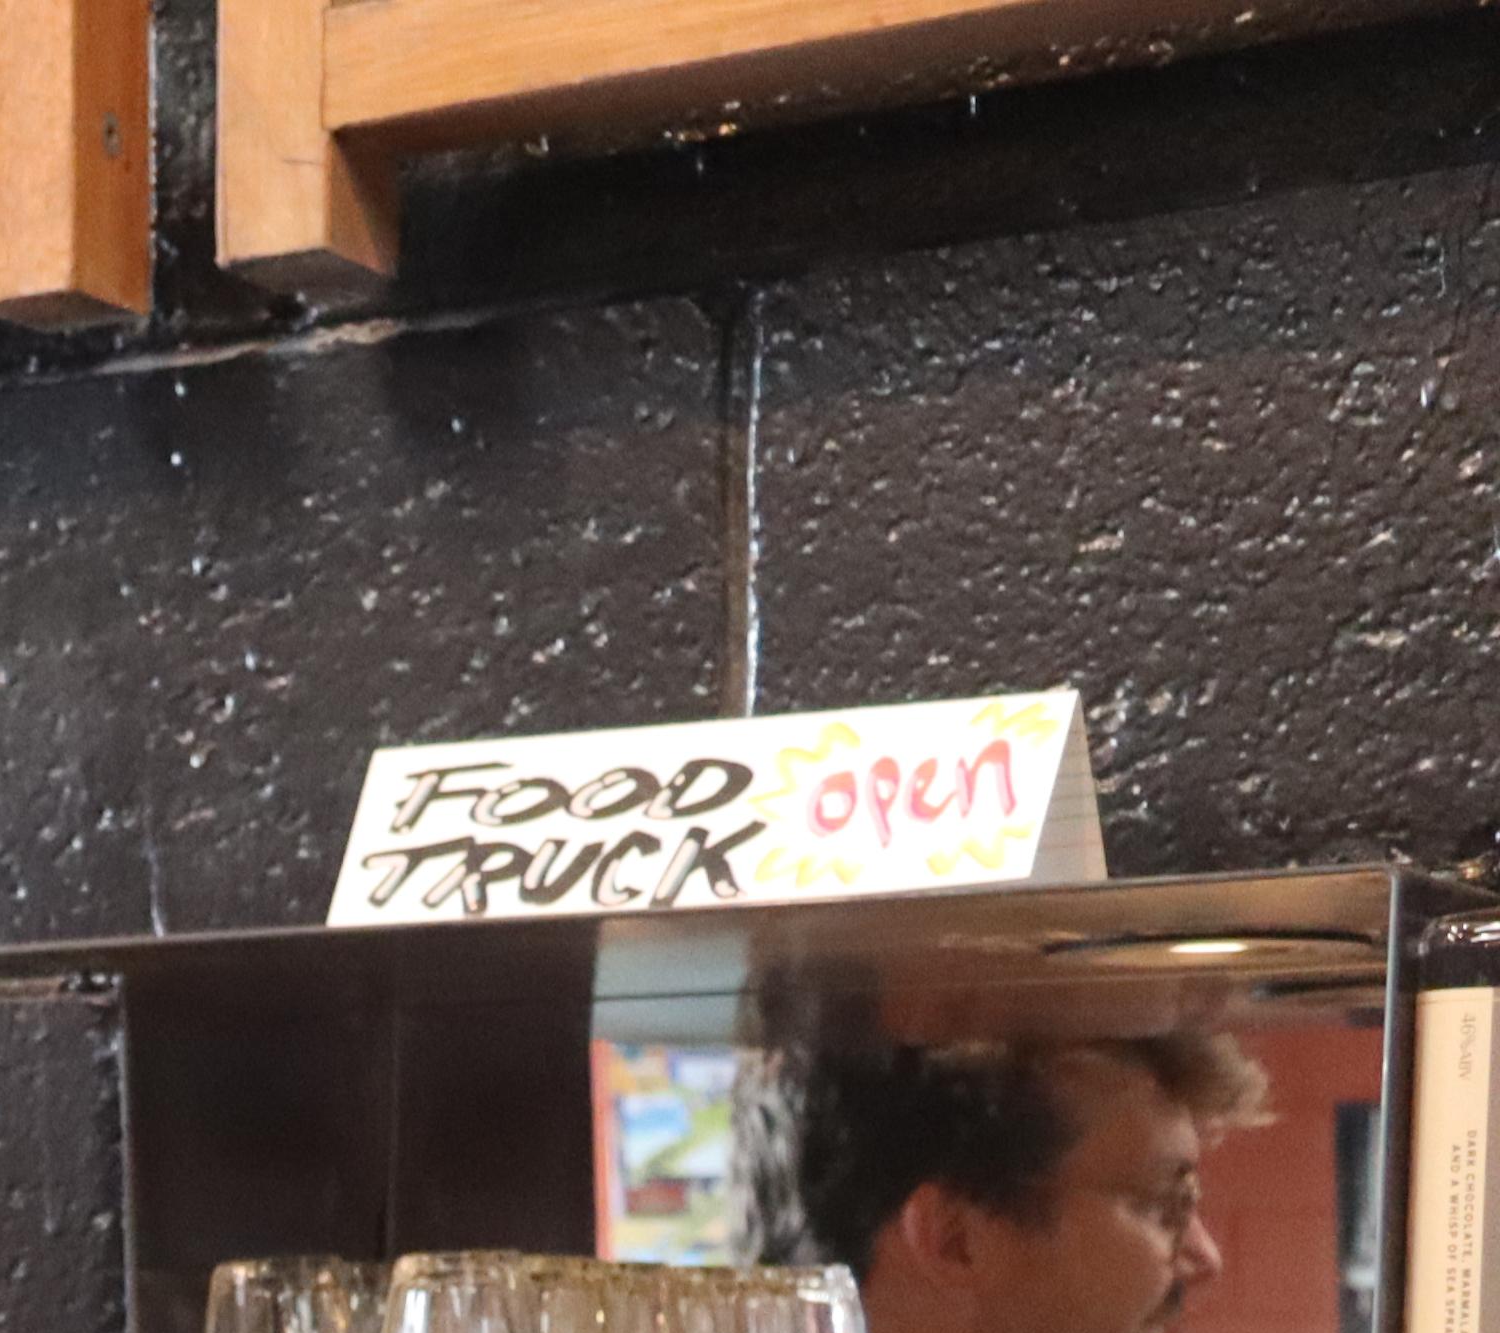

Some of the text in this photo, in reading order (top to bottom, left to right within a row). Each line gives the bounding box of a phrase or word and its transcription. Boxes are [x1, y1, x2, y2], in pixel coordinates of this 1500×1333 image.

[395, 757, 754, 835] FOOD
[805, 739, 1017, 849] open
[361, 820, 767, 916] TRUCK
[1450, 1143, 1461, 1173] AND
[1466, 1129, 1478, 1168] DARK
[1461, 1172, 1477, 1264] CHOCOLATE,
[1445, 1267, 1456, 1294] SEA
[1446, 1244, 1457, 1261] OF
